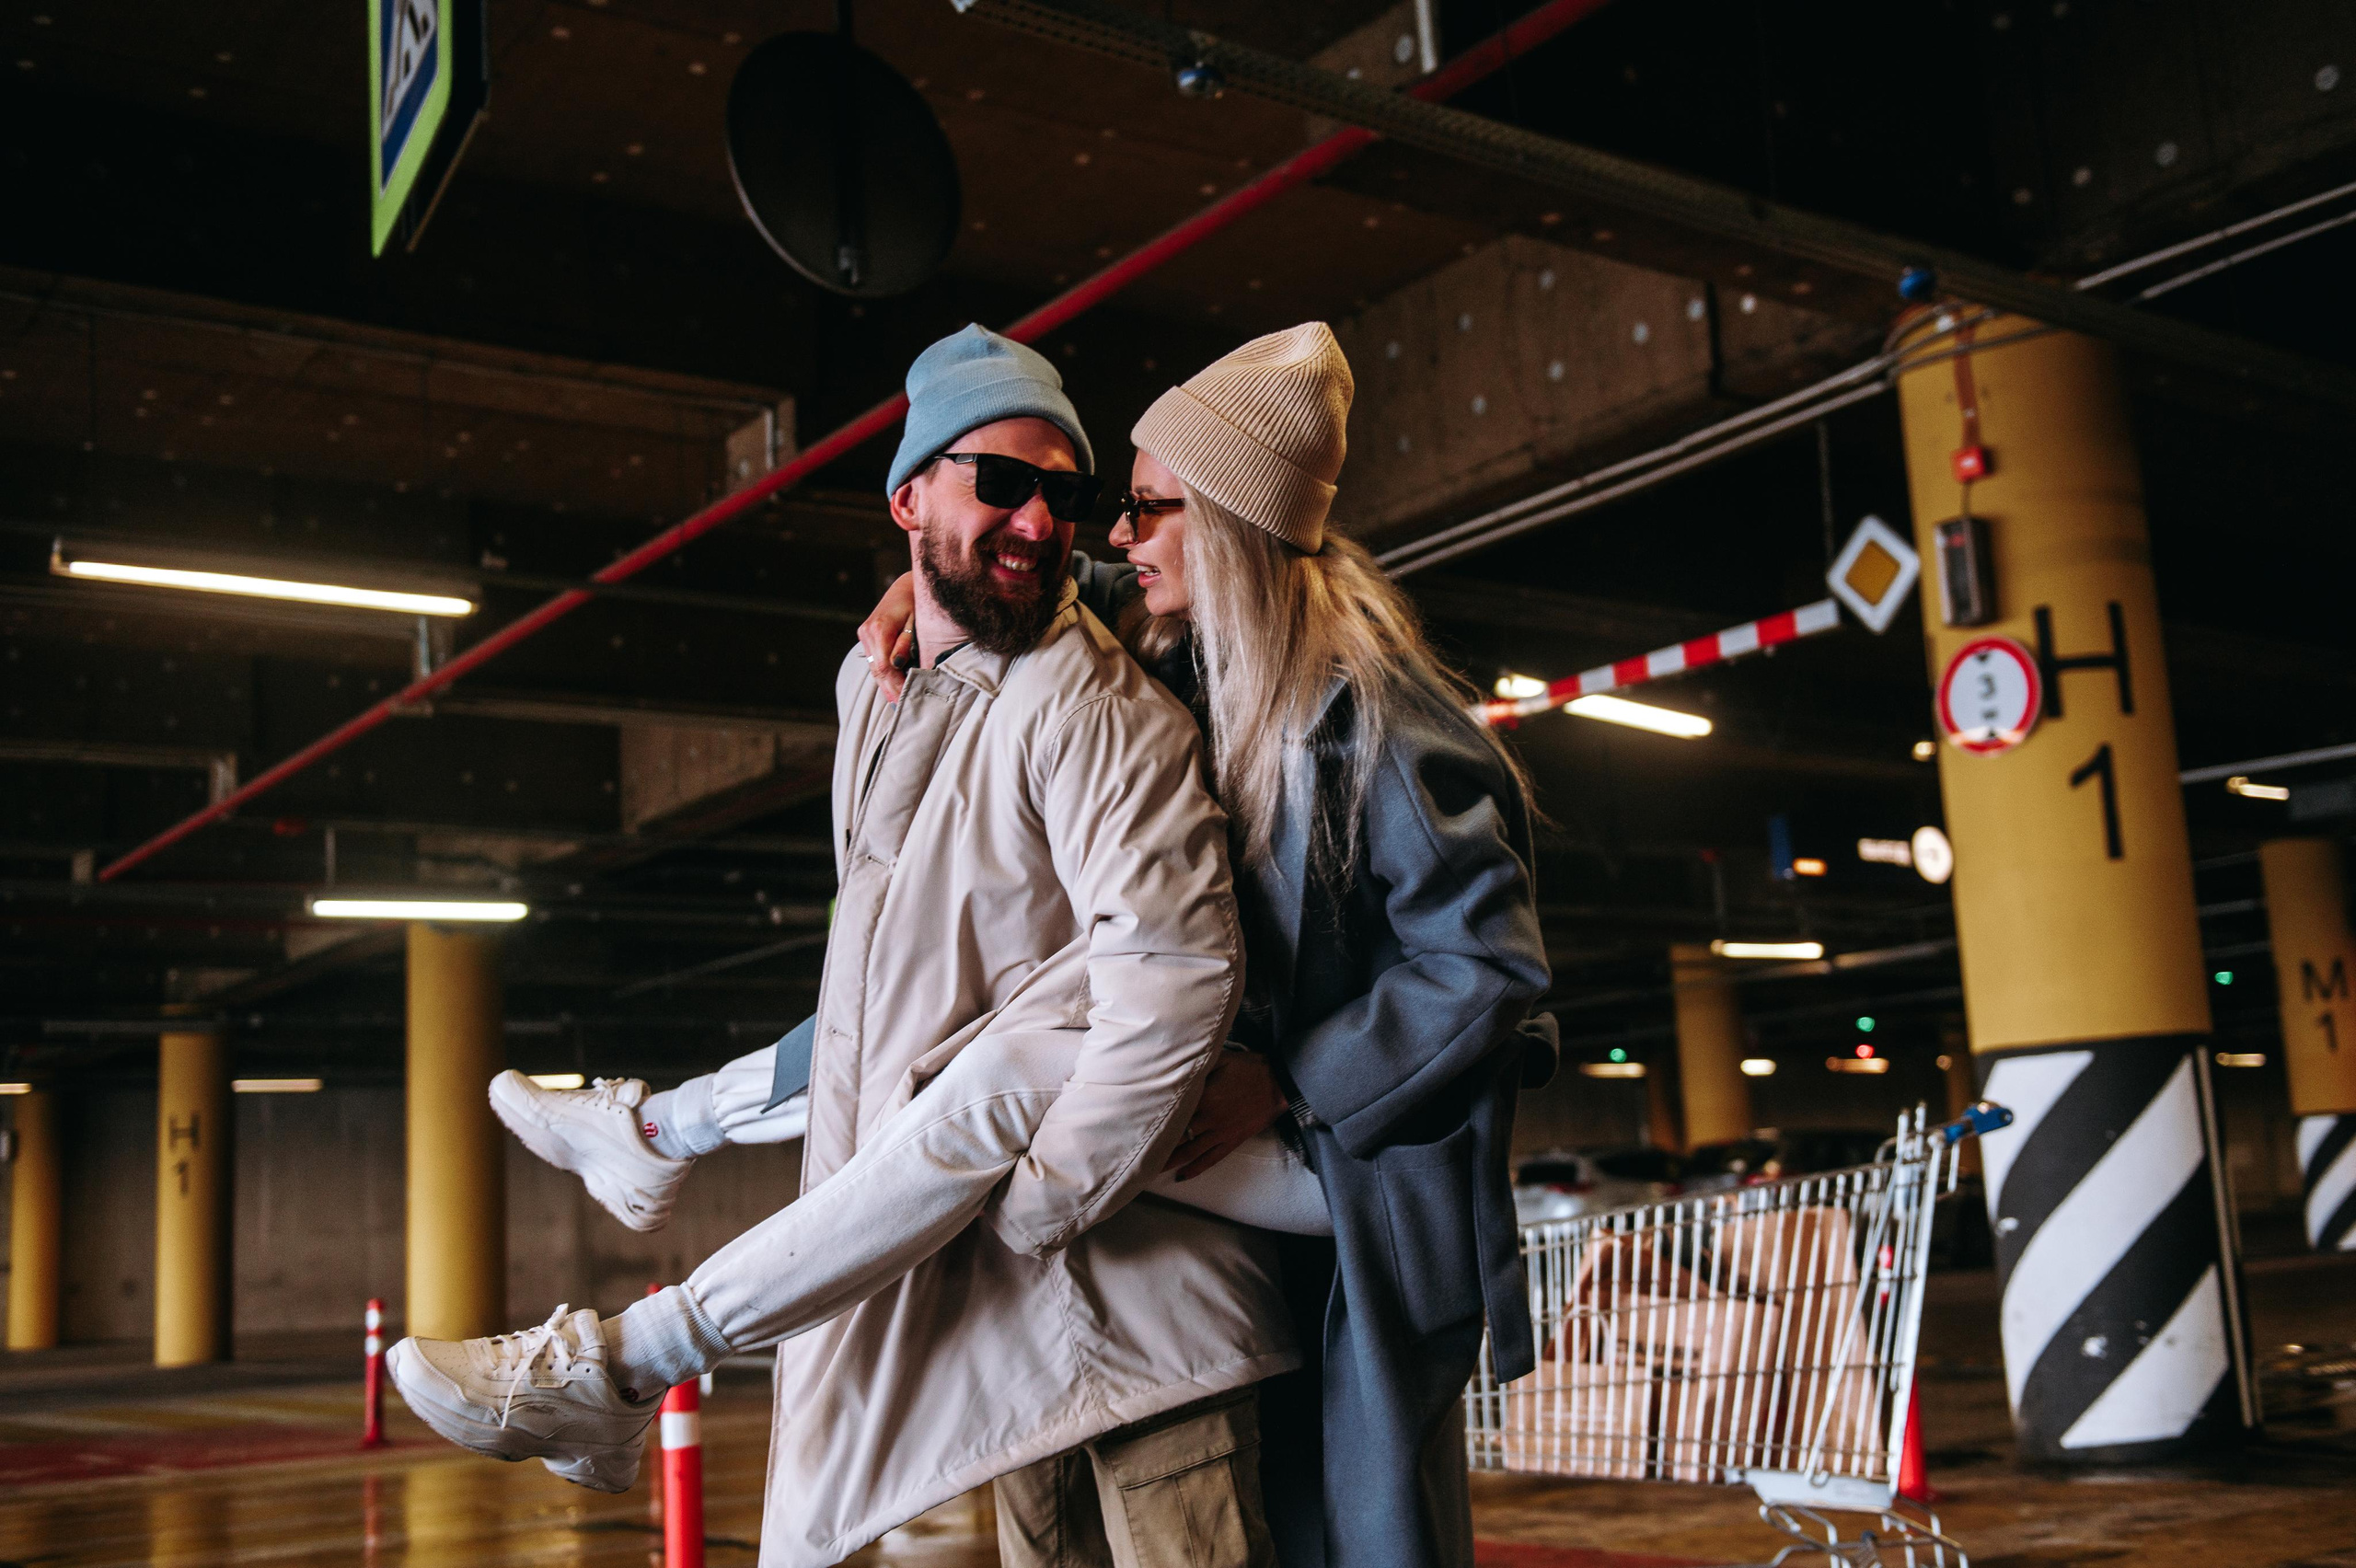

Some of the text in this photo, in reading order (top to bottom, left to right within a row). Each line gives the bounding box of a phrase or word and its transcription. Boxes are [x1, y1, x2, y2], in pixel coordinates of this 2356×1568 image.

[2034, 602, 2134, 719] H
[2069, 743, 2122, 860] 1
[2303, 957, 2350, 1003] M
[2316, 1013, 2339, 1052] 1
[167, 1113, 201, 1152] H
